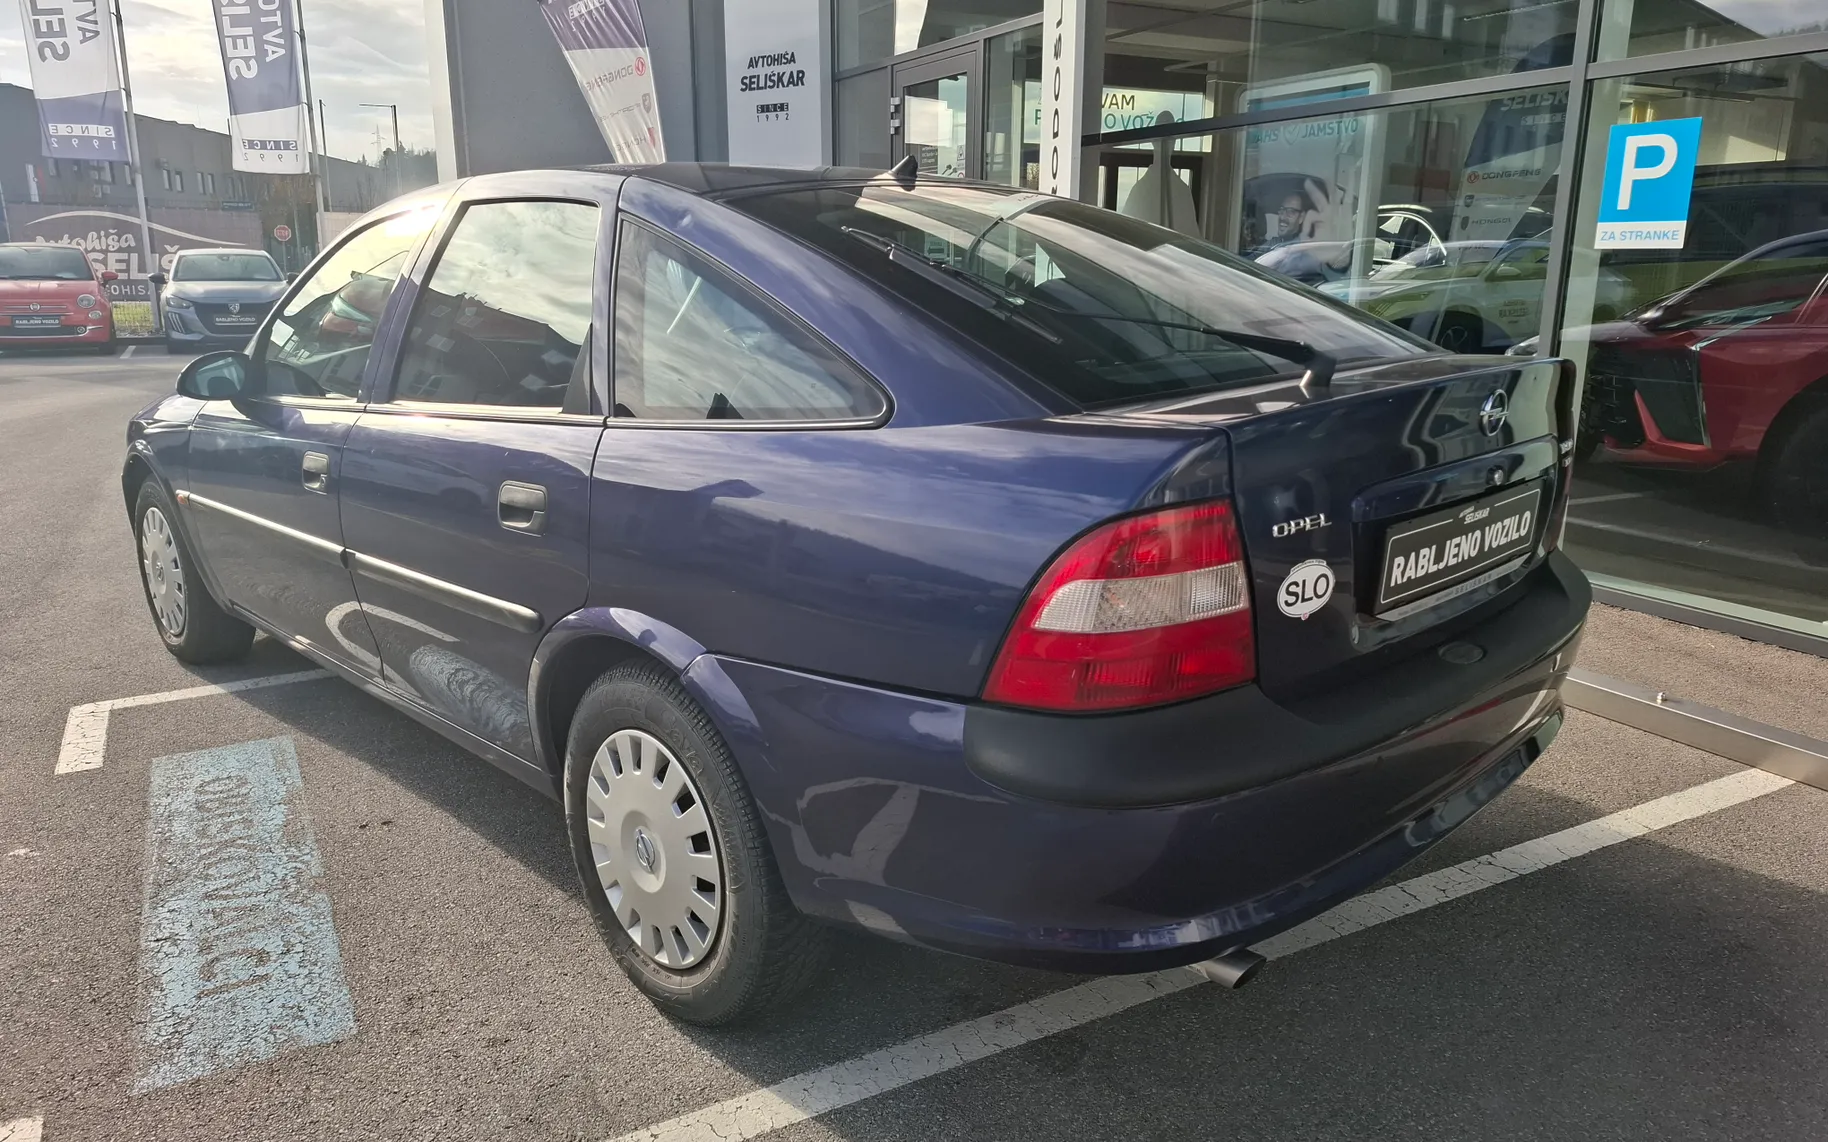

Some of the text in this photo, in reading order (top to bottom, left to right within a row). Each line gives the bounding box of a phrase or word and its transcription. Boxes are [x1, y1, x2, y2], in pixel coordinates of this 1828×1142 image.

[747, 51, 796, 69] AVTOHIŠA
[740, 70, 805, 92] SELIŠKAR
[757, 103, 788, 113] SINCE
[757, 113, 789, 122] 1992
[1301, 119, 1358, 138] JAMSTVO
[1482, 168, 1542, 180] DONGFENG
[1617, 134, 1678, 210] P
[1601, 230, 1680, 241] ZA STRANKE
[1272, 513, 1332, 538] OPEL
[1390, 510, 1531, 587] RABLJENO VOZILO
[1284, 573, 1330, 607] SLO
